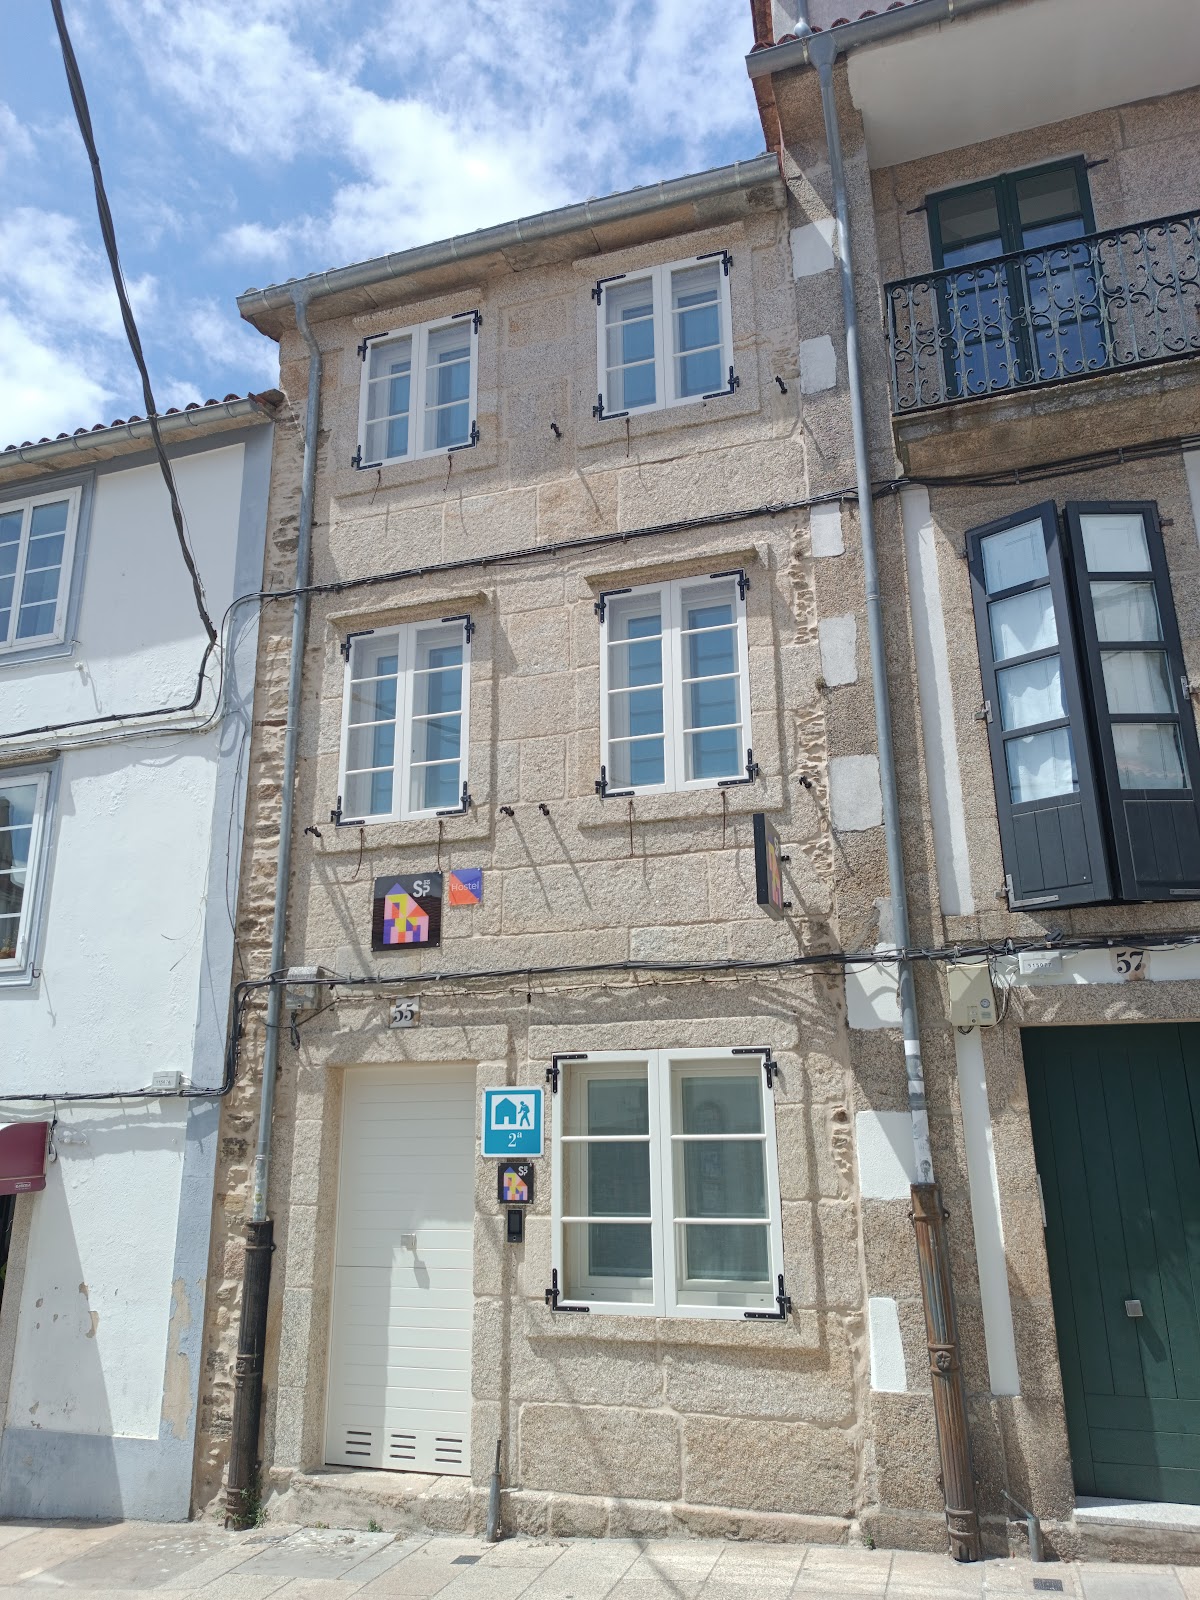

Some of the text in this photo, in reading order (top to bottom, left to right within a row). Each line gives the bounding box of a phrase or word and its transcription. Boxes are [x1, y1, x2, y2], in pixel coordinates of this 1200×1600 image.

[451, 880, 480, 892] Hostel
[1116, 951, 1145, 974] 57
[393, 1002, 415, 1023] 55
